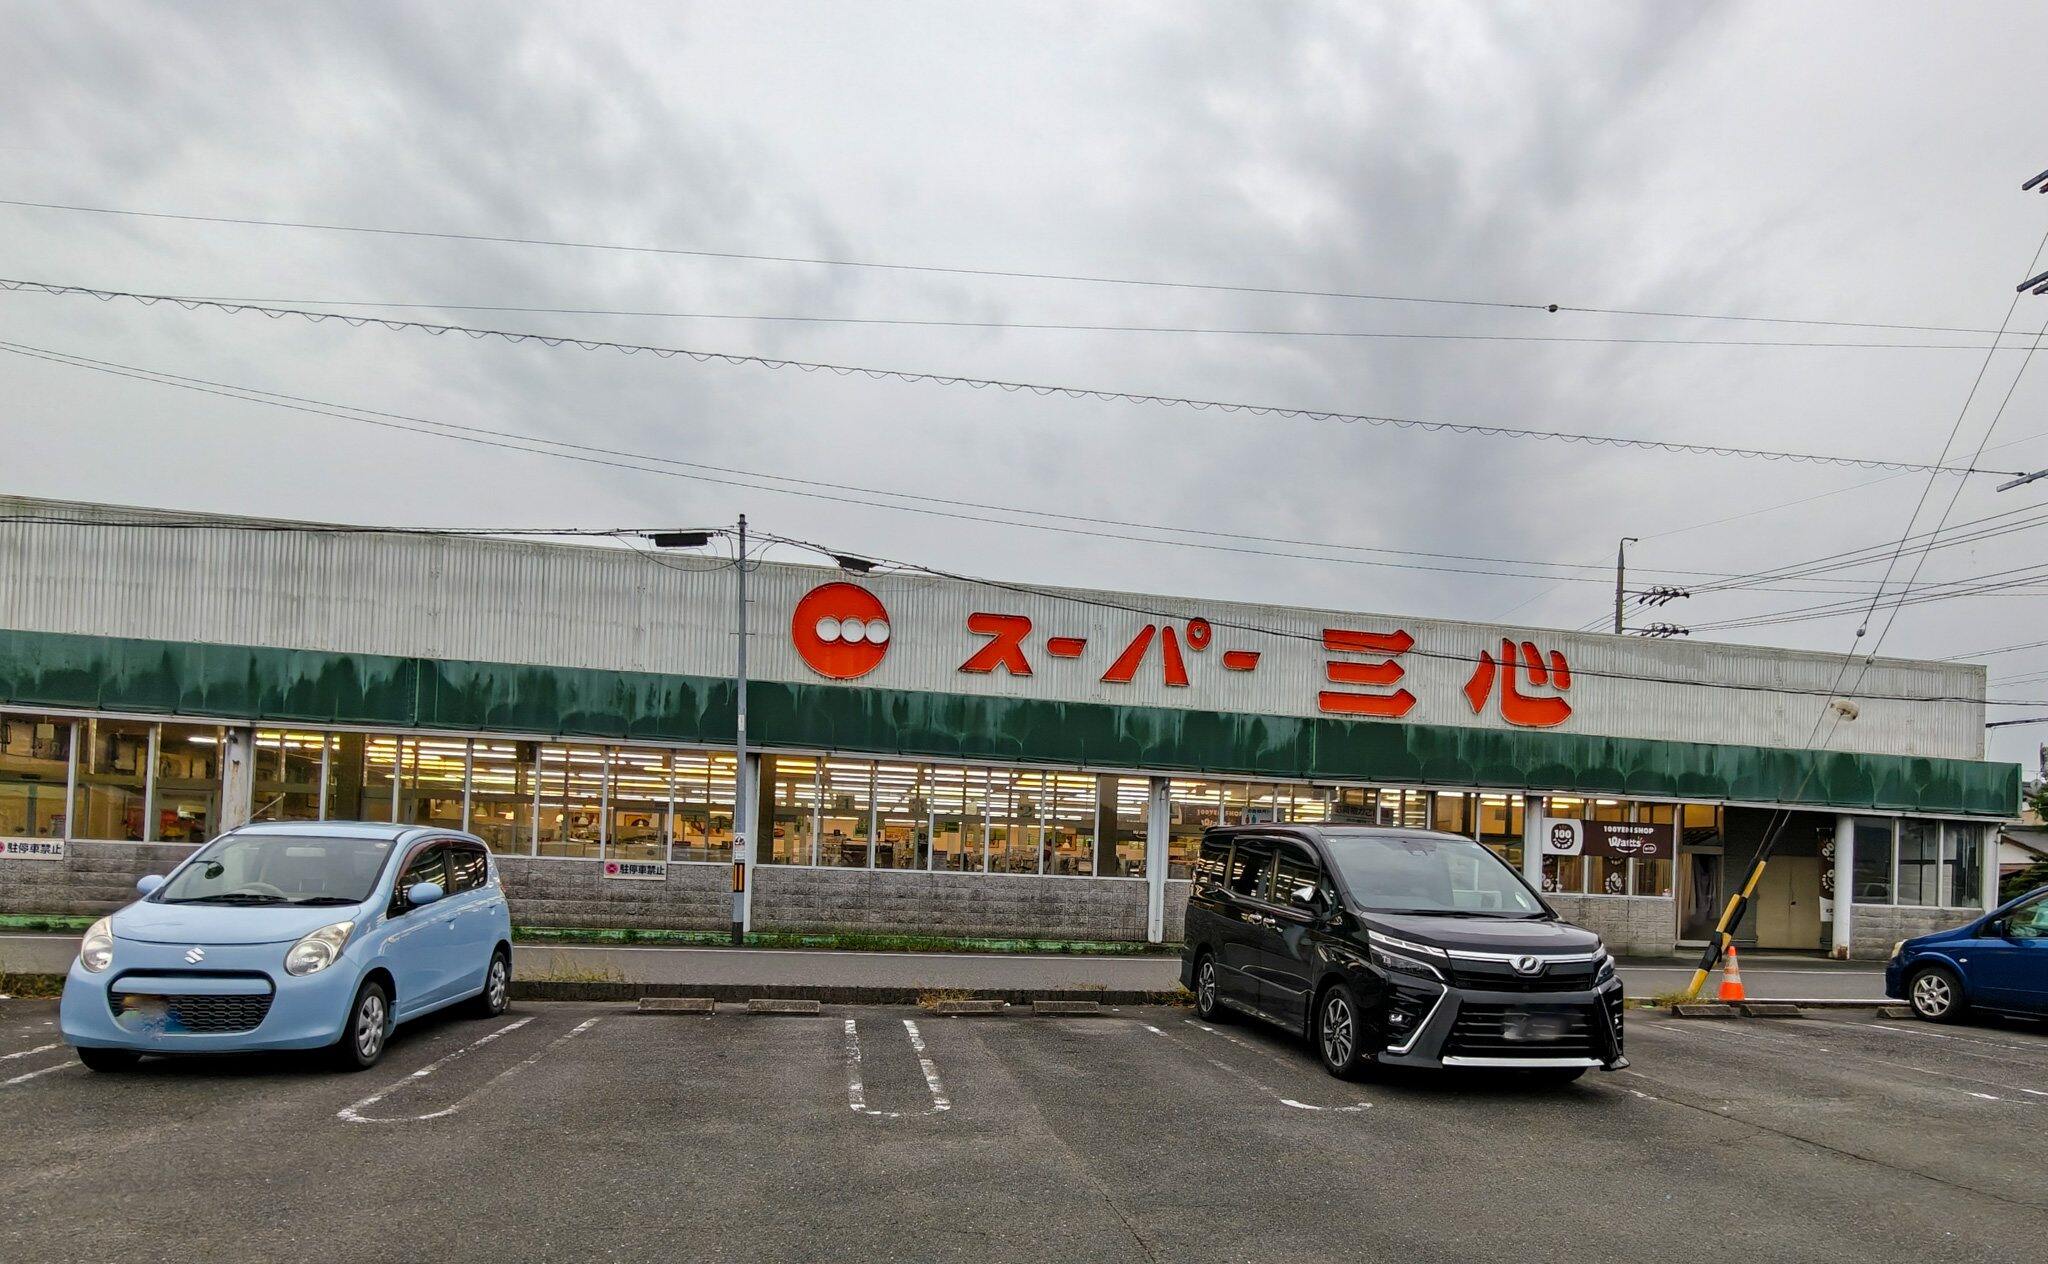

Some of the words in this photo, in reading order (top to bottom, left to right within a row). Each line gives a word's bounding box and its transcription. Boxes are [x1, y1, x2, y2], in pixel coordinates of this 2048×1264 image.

[1554, 829, 1572, 838] 100
[1608, 836, 1641, 848] Watts
[7, 842, 62, 855] 駐停車禁止
[619, 863, 666, 876] 駐停車禁止
